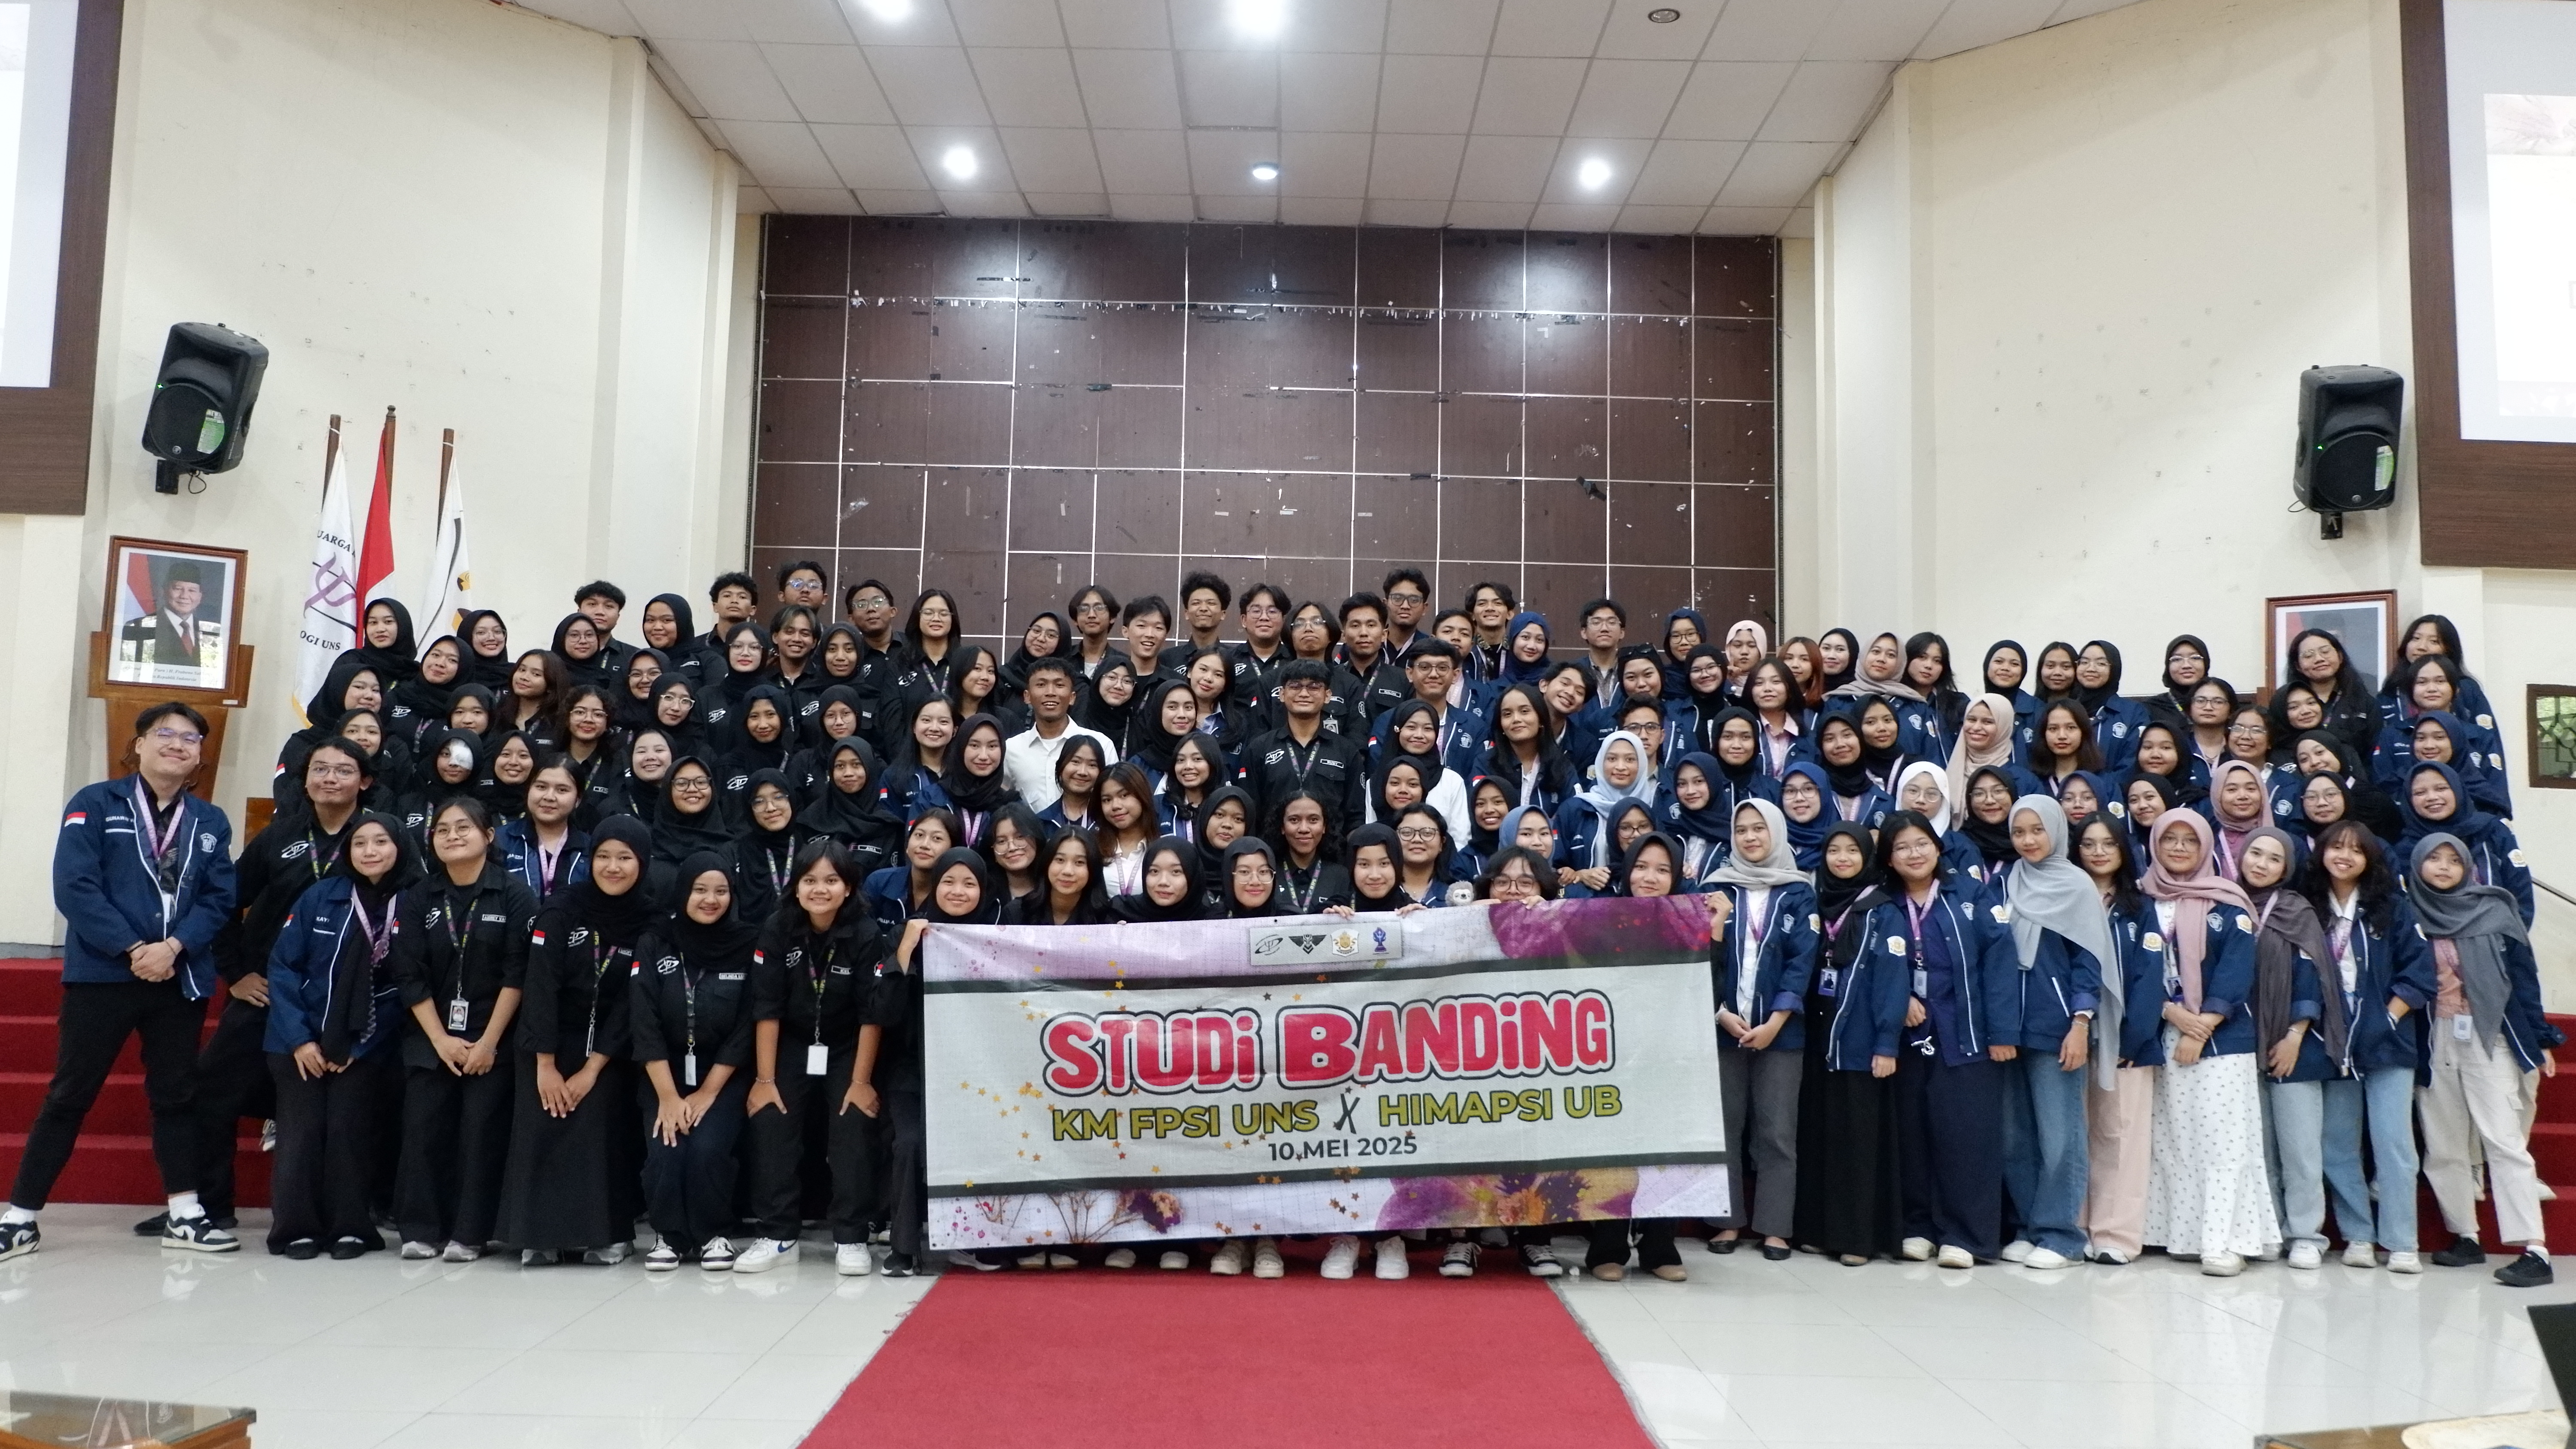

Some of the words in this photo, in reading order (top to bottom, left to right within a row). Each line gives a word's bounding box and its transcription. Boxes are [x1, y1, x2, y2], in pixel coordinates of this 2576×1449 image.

[322, 640, 341, 650] UNS
[1052, 1109, 1118, 1141] KM
[1130, 1105, 1220, 1139] FPSI
[1232, 1100, 1320, 1135] UNS
[1379, 1088, 1553, 1127] HIMAPSI
[1564, 1085, 1622, 1119] UB
[1268, 1142, 1294, 1161] 10
[1303, 1139, 1349, 1159] MEI
[1357, 1135, 1417, 1156] 2025
